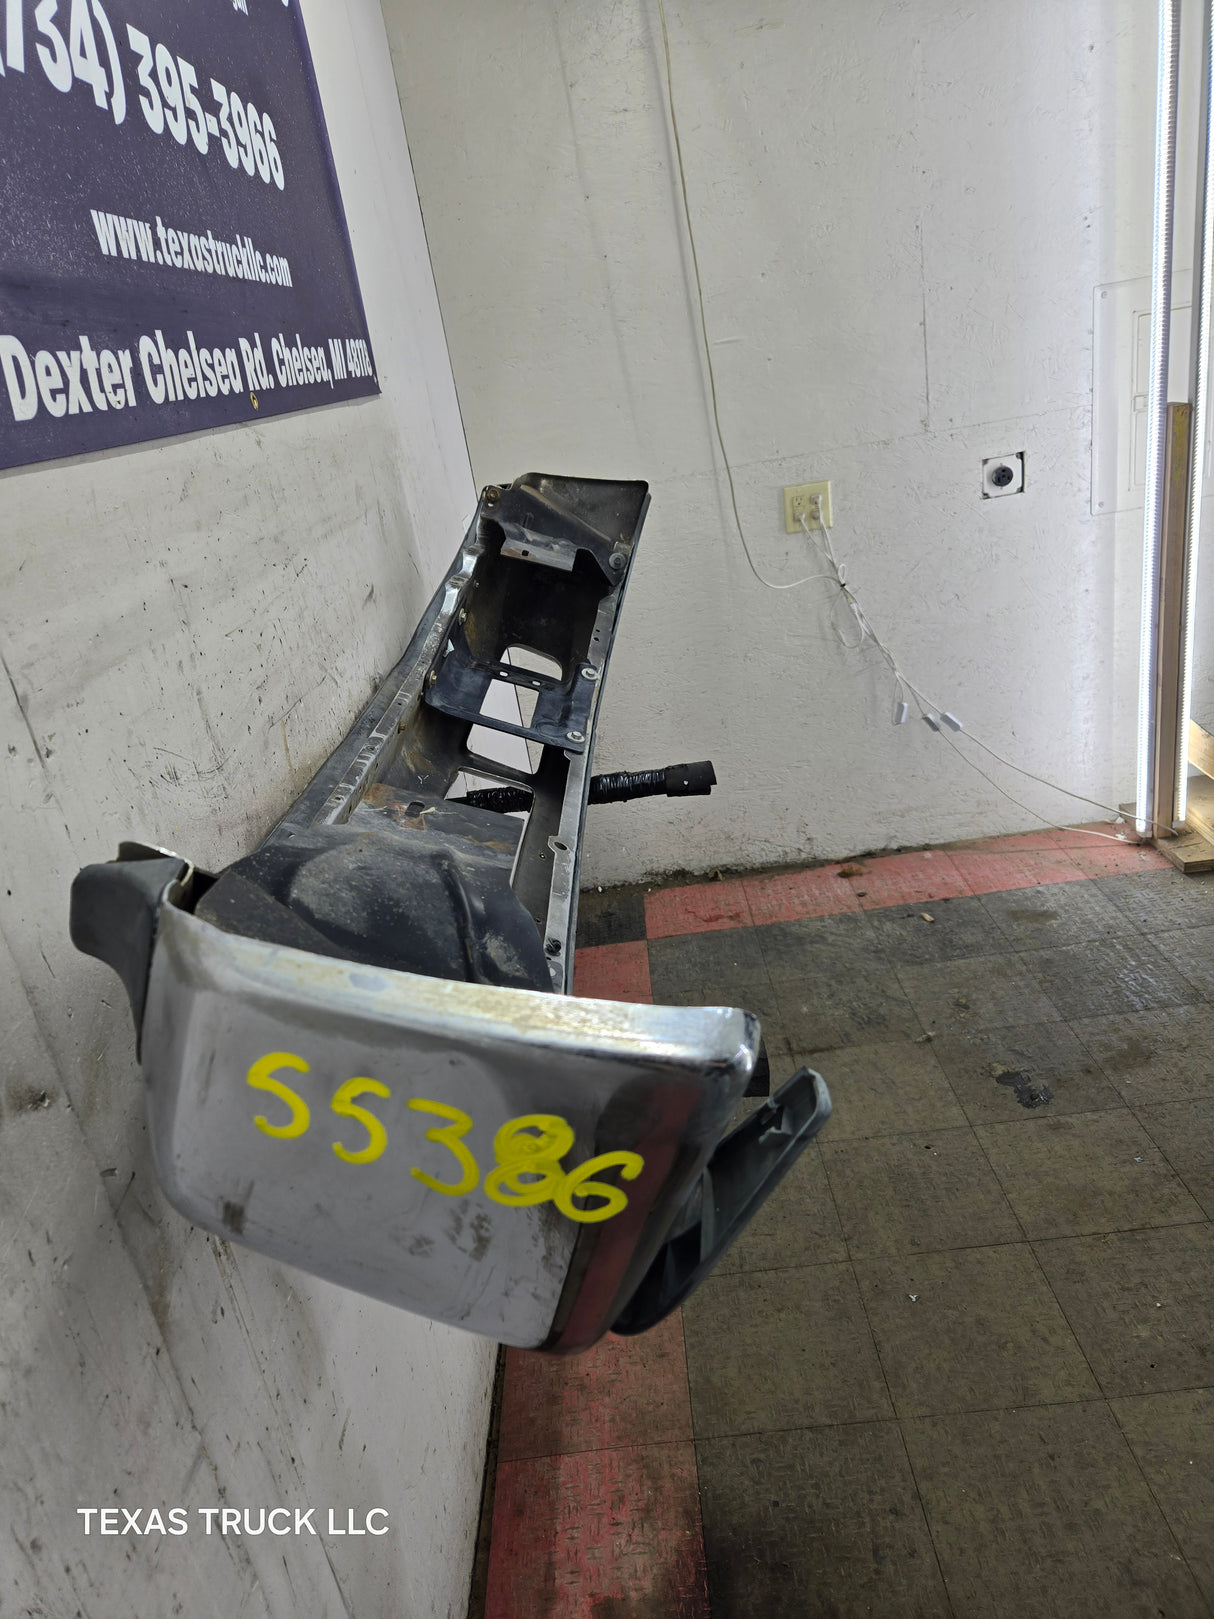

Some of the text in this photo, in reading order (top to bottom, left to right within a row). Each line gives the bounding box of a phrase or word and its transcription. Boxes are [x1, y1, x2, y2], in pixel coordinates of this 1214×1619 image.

[0, 0, 285, 191] 34) 395-3966
[90, 208, 293, 288] www.texastruckllc.com
[0, 329, 373, 421] Dexter Chelsea Rd. Chelsea, MI 48118
